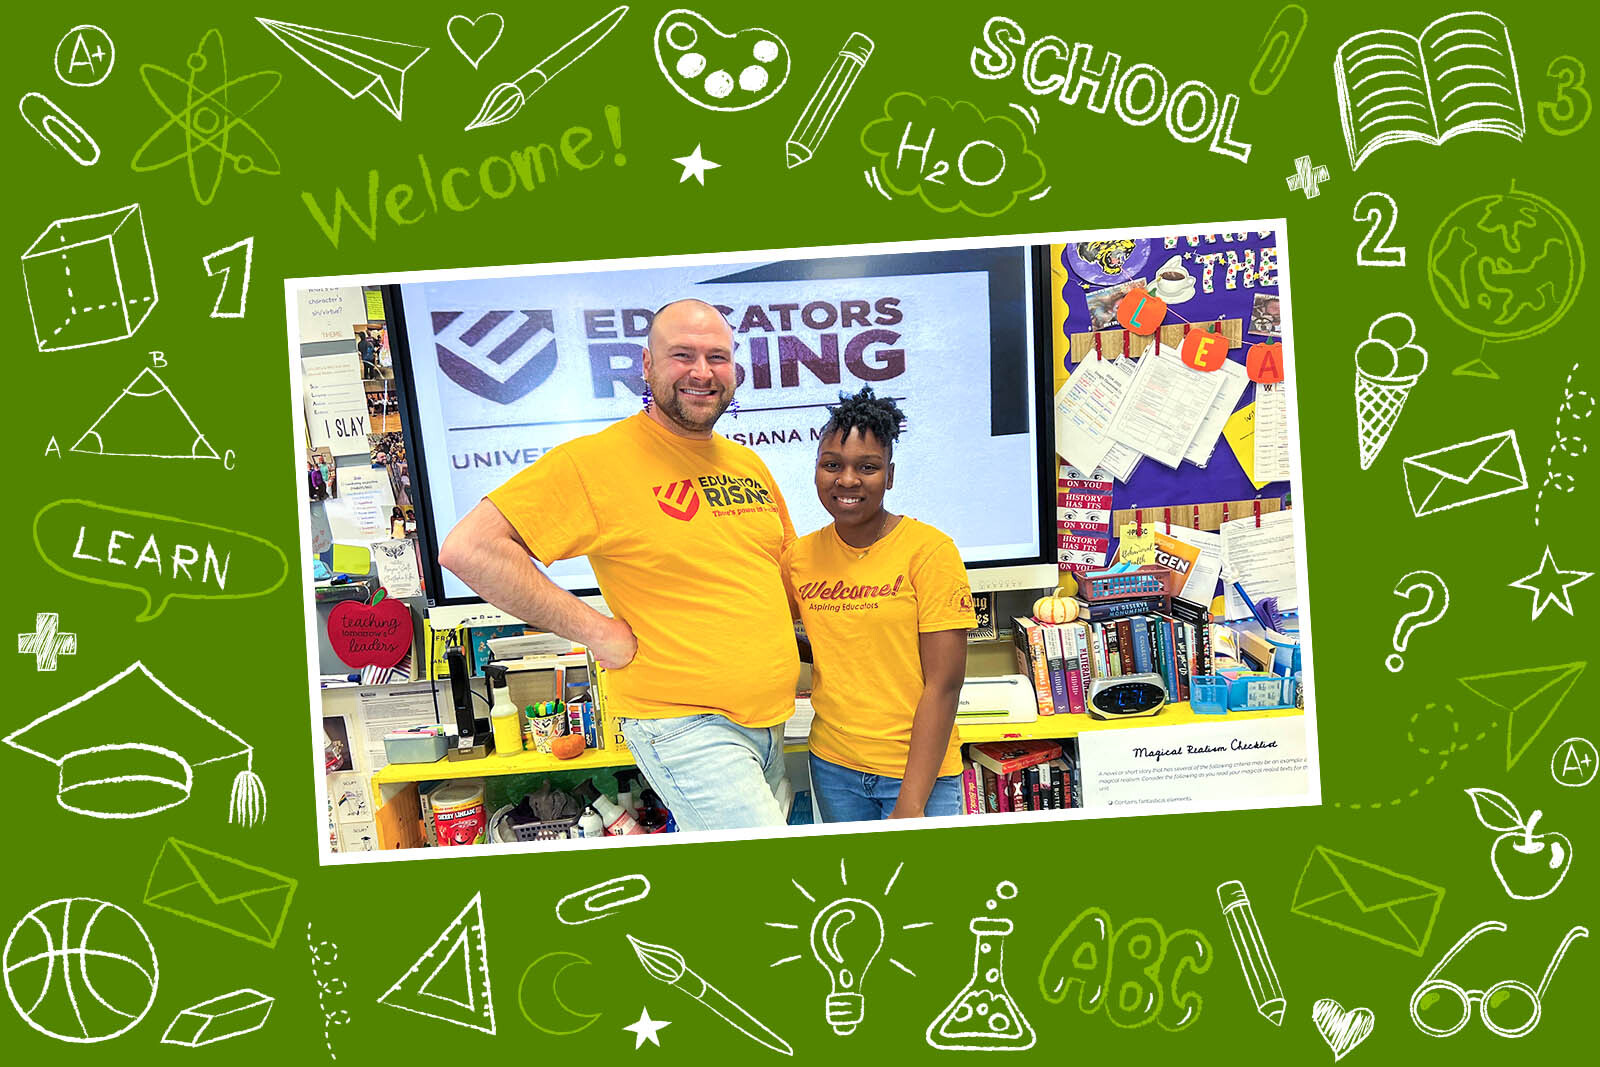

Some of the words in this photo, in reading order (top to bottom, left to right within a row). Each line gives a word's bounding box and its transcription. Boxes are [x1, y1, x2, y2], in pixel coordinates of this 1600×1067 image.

[335, 416, 365, 438] SLAY
[1066, 494, 1103, 502] HISTORY
[1062, 536, 1099, 544] HISTORY
[1076, 564, 1094, 572] YOU
[799, 574, 905, 601] Welcome!
[808, 602, 841, 613] Aspiring
[342, 612, 400, 635] teaching
[350, 638, 399, 652] leaders
[1132, 746, 1182, 762] Magical
[1186, 744, 1227, 754] Realism
[1230, 738, 1278, 751] Checklist
